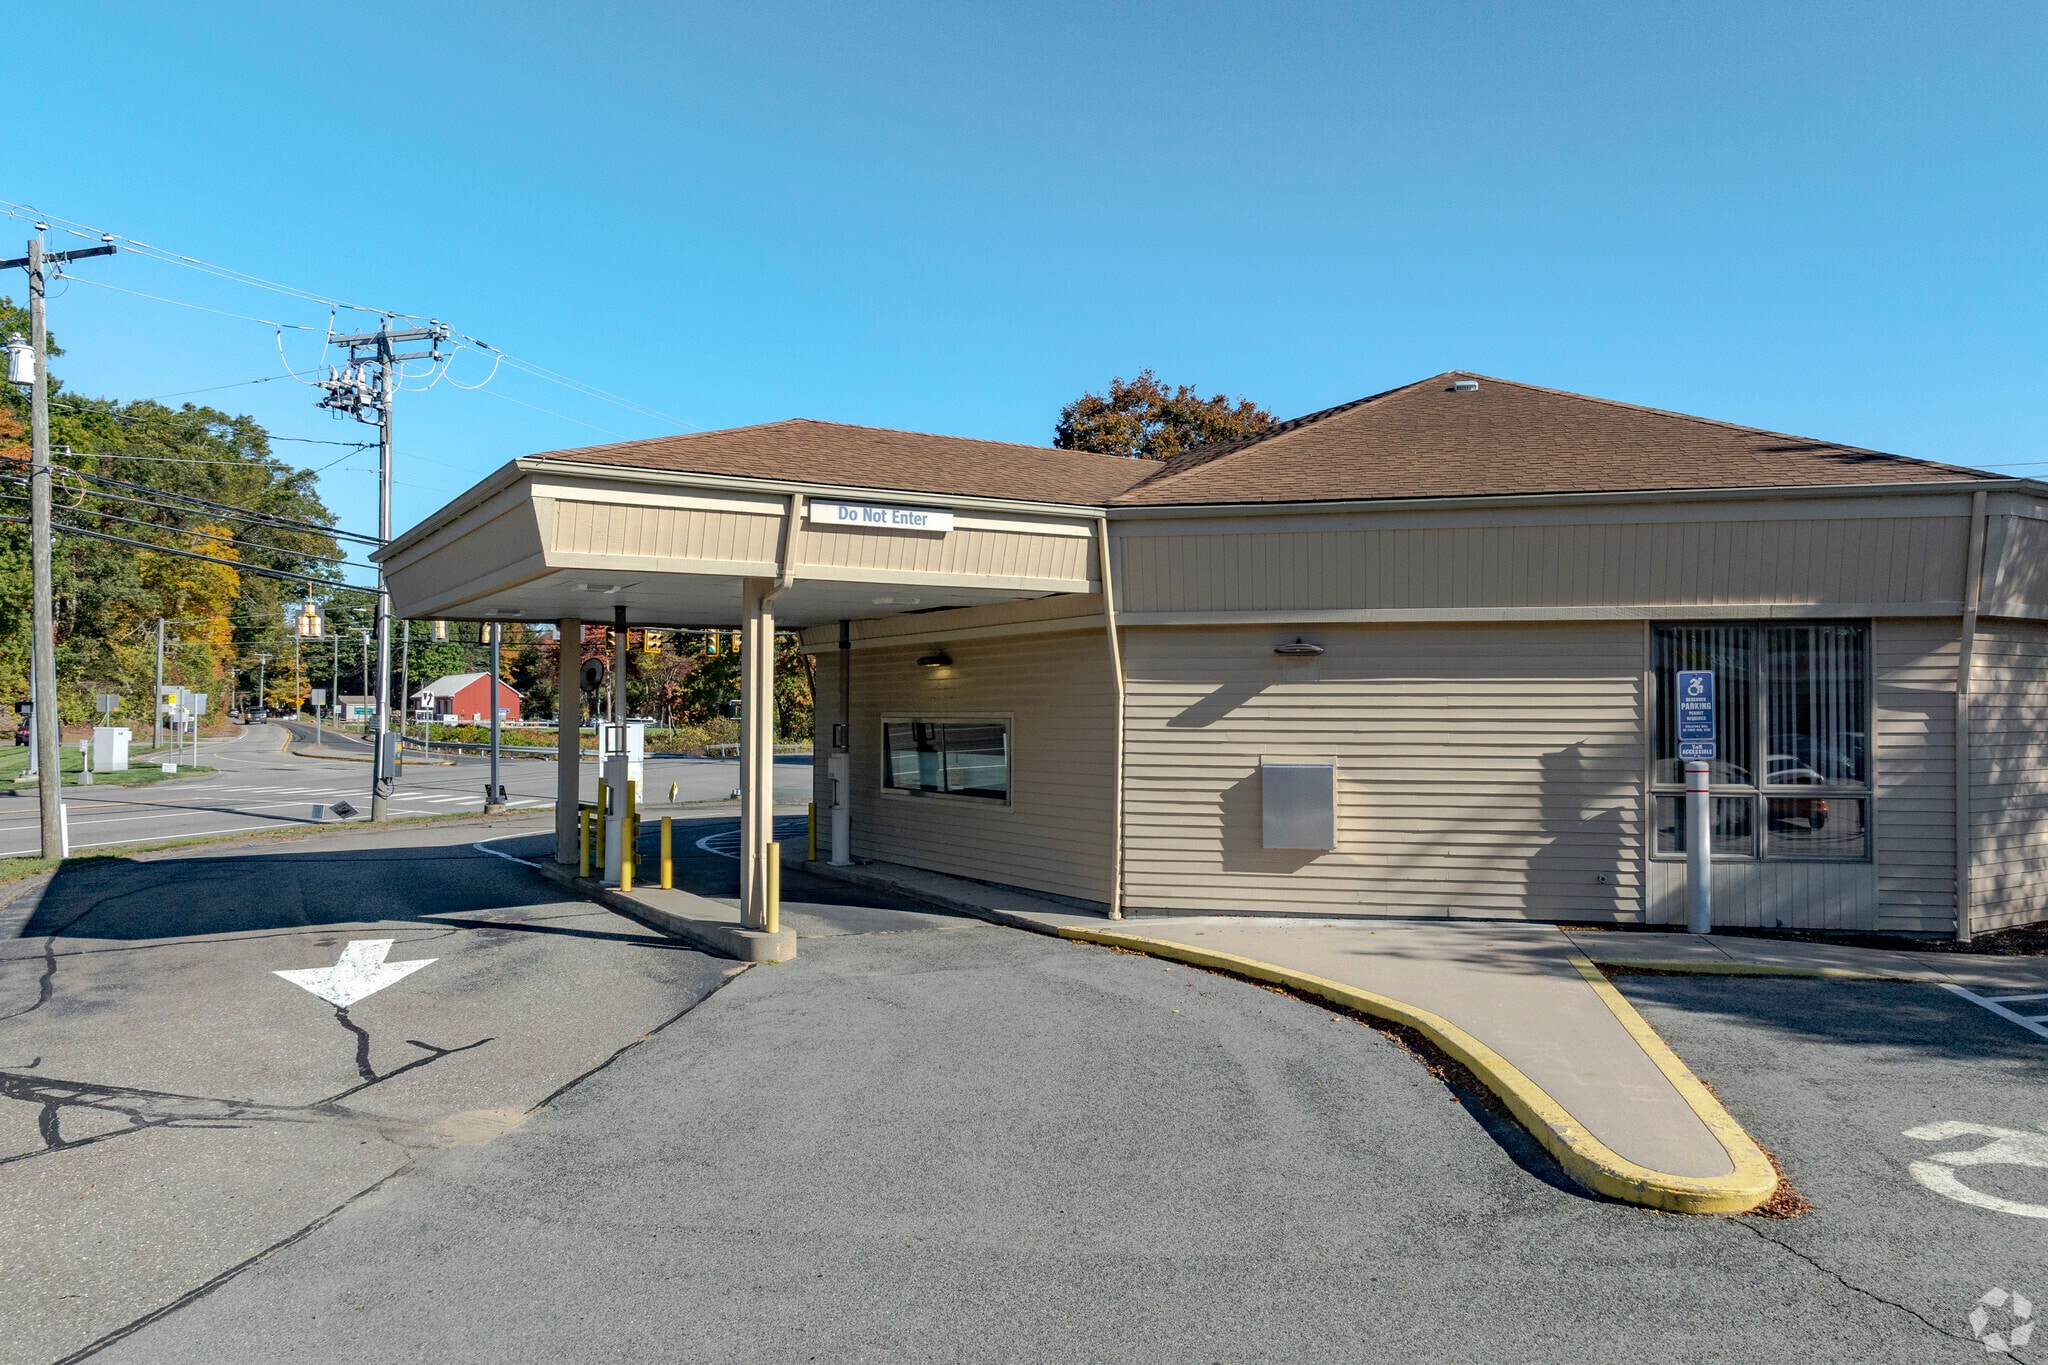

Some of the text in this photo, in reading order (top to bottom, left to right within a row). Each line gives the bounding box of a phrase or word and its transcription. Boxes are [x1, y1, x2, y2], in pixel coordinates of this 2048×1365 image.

[838, 505, 928, 526] Do Not Enter
[1681, 702, 1711, 710] PARKING
